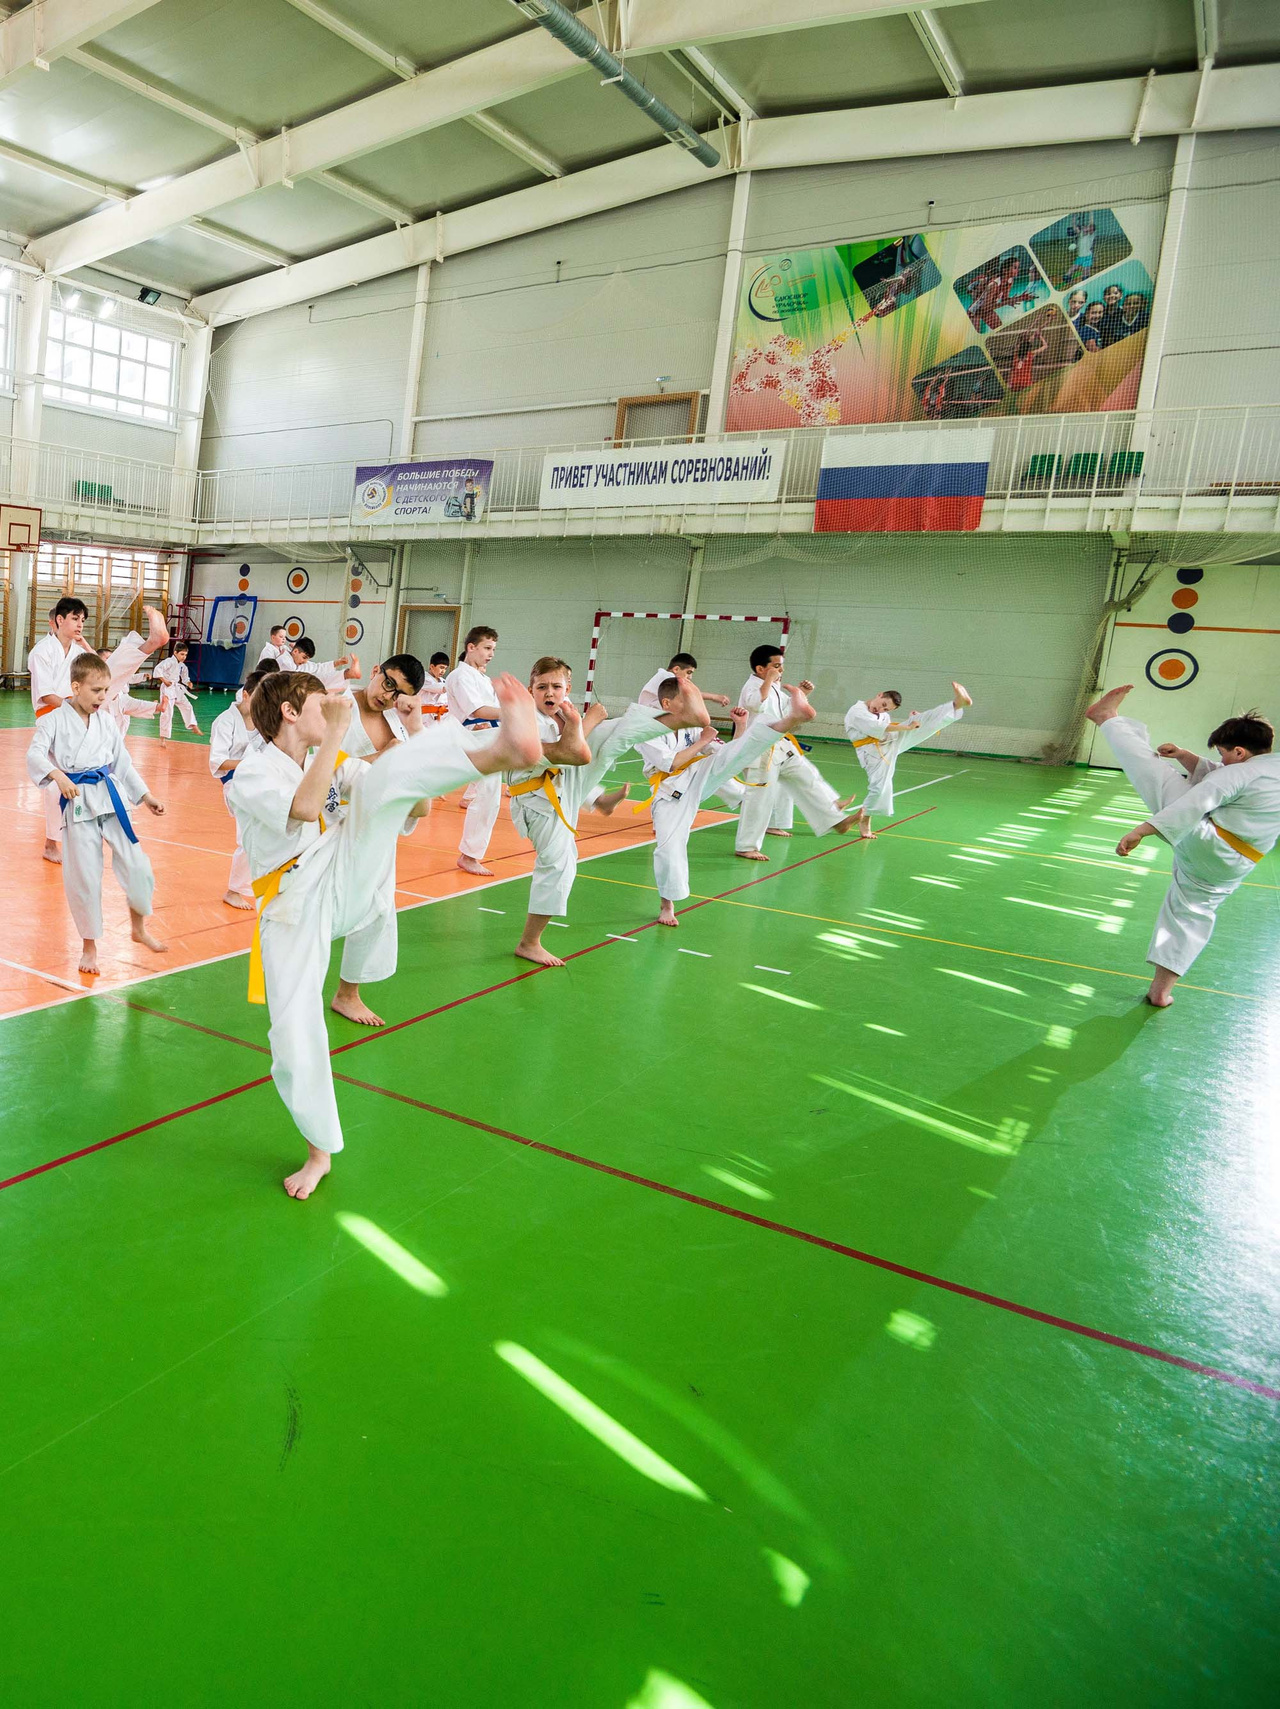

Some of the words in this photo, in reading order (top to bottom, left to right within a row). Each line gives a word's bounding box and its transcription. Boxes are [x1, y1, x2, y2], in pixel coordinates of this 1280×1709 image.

[550, 464, 593, 489] ПРИВЕТ
[593, 460, 668, 488] УЧАСТНИКАМ
[670, 447, 772, 484] СОРЕВНОВАНИЙ!
[397, 470, 441, 481] БОЛЬШИЕ
[442, 468, 480, 478] ПОБЕДЫ
[396, 481, 459, 492] НАЧИНАЮТСЯ
[395, 496, 401, 504] С
[402, 494, 447, 505] ДЕТСКОГО
[394, 506, 431, 515] СПОРТА!
